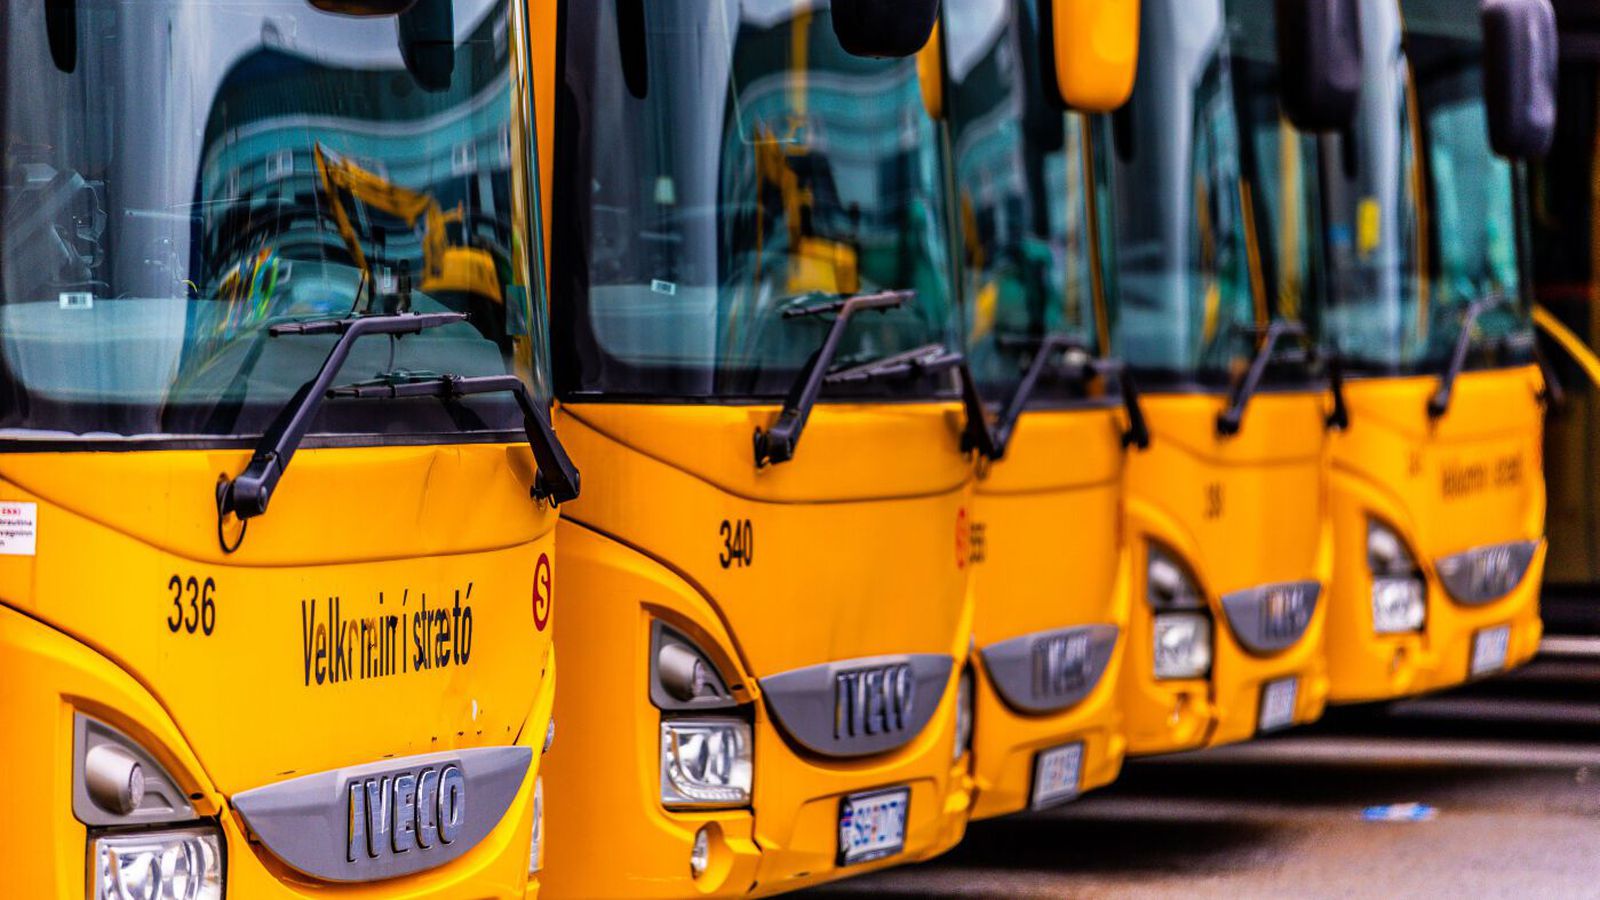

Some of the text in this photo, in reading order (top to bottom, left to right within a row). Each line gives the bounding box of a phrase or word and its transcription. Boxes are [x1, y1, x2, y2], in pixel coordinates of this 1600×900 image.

[719, 519, 753, 569] 340
[167, 574, 216, 637] 336
[413, 582, 473, 672] strætó
[346, 764, 465, 862] IVECO
